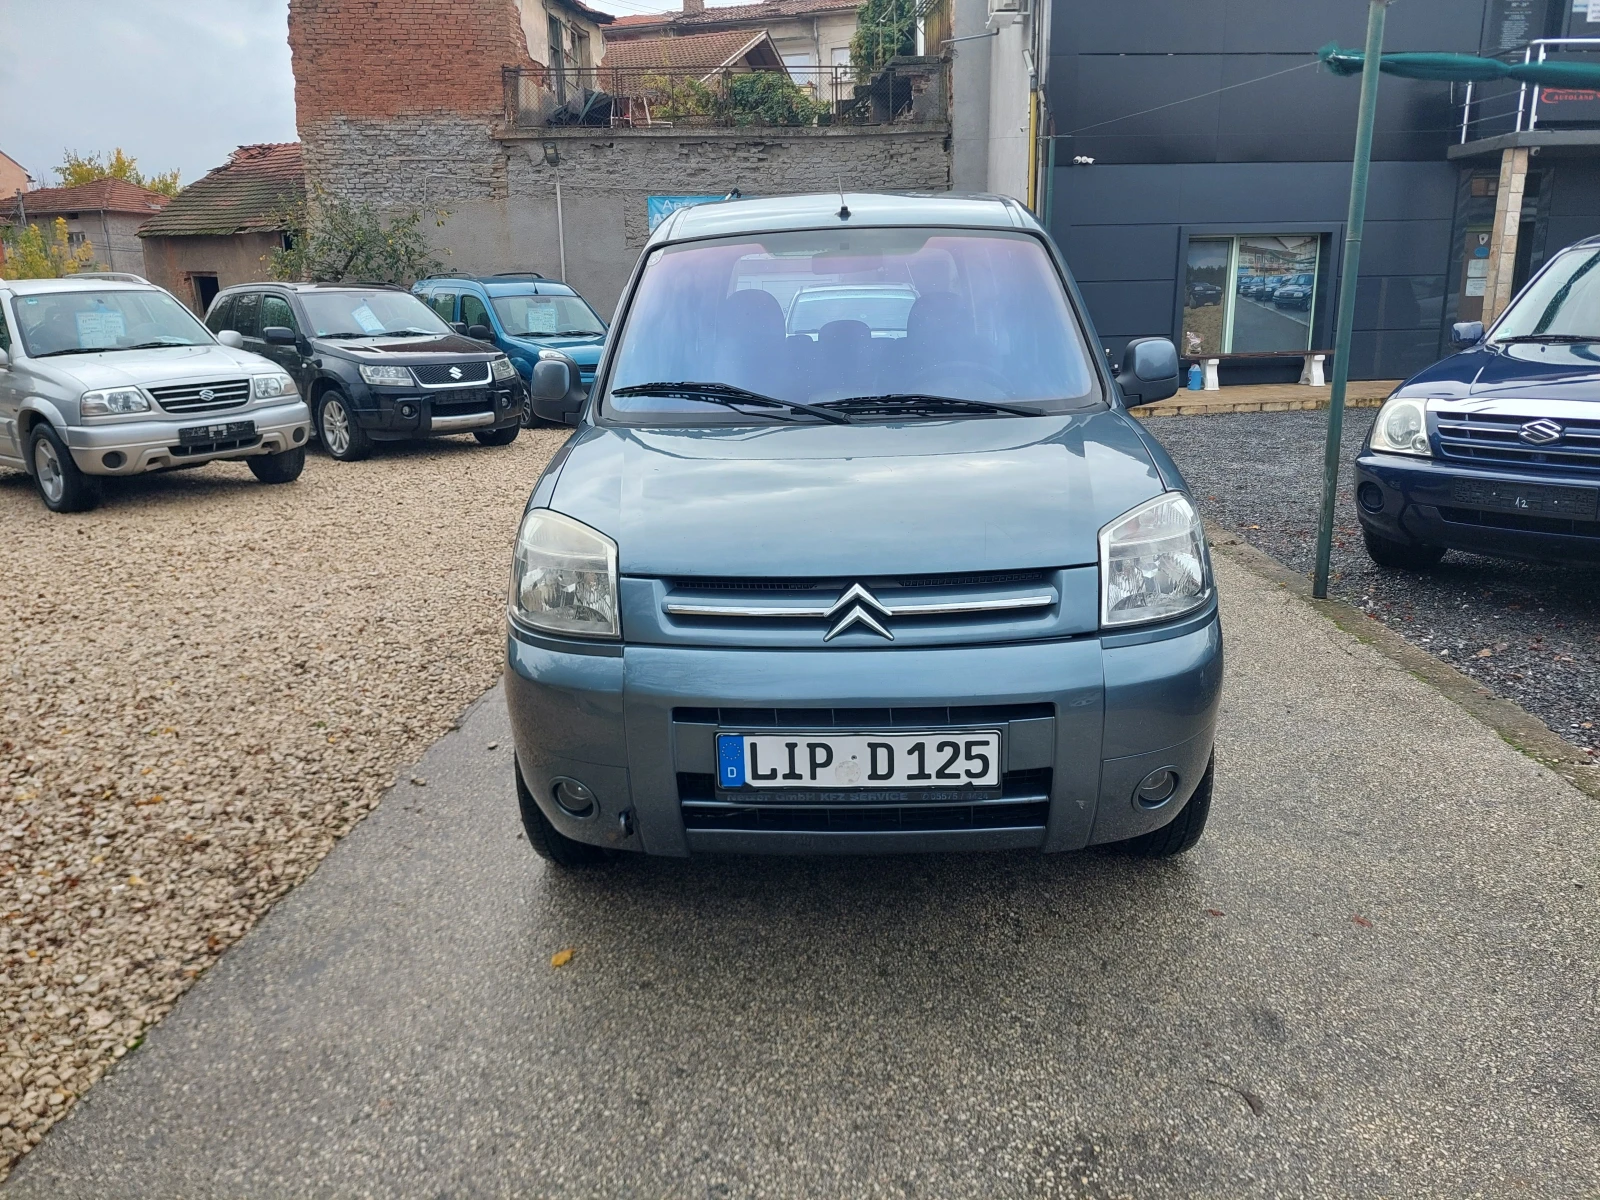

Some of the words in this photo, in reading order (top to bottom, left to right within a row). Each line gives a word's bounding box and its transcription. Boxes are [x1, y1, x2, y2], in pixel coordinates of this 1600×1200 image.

[1514, 496, 1529, 508] 12
[749, 742, 834, 780] LIP
[728, 766, 737, 778] D
[776, 793, 816, 801] GmbH
[820, 793, 846, 801] KFZ
[850, 792, 909, 801] SERVICE
